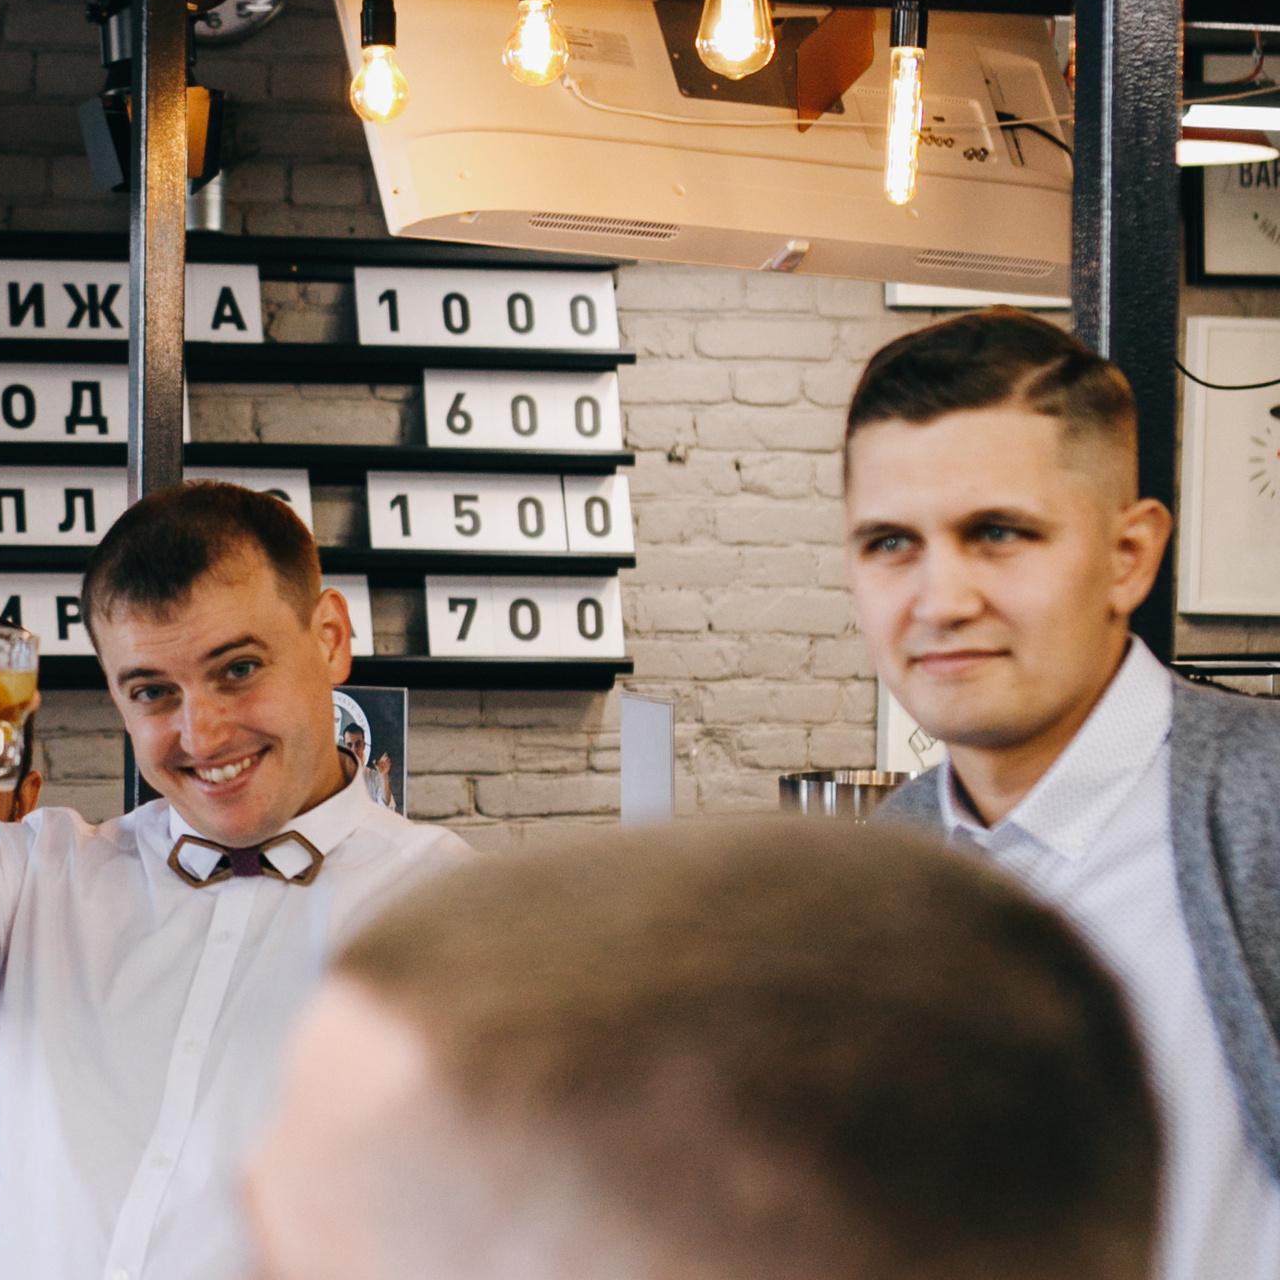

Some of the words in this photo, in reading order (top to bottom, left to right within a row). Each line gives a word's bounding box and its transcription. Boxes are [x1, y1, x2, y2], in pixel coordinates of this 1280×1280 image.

[378, 289, 598, 336] 1000
[446, 393, 602, 437] 600
[390, 494, 612, 538] 1500
[448, 597, 604, 641] 700
